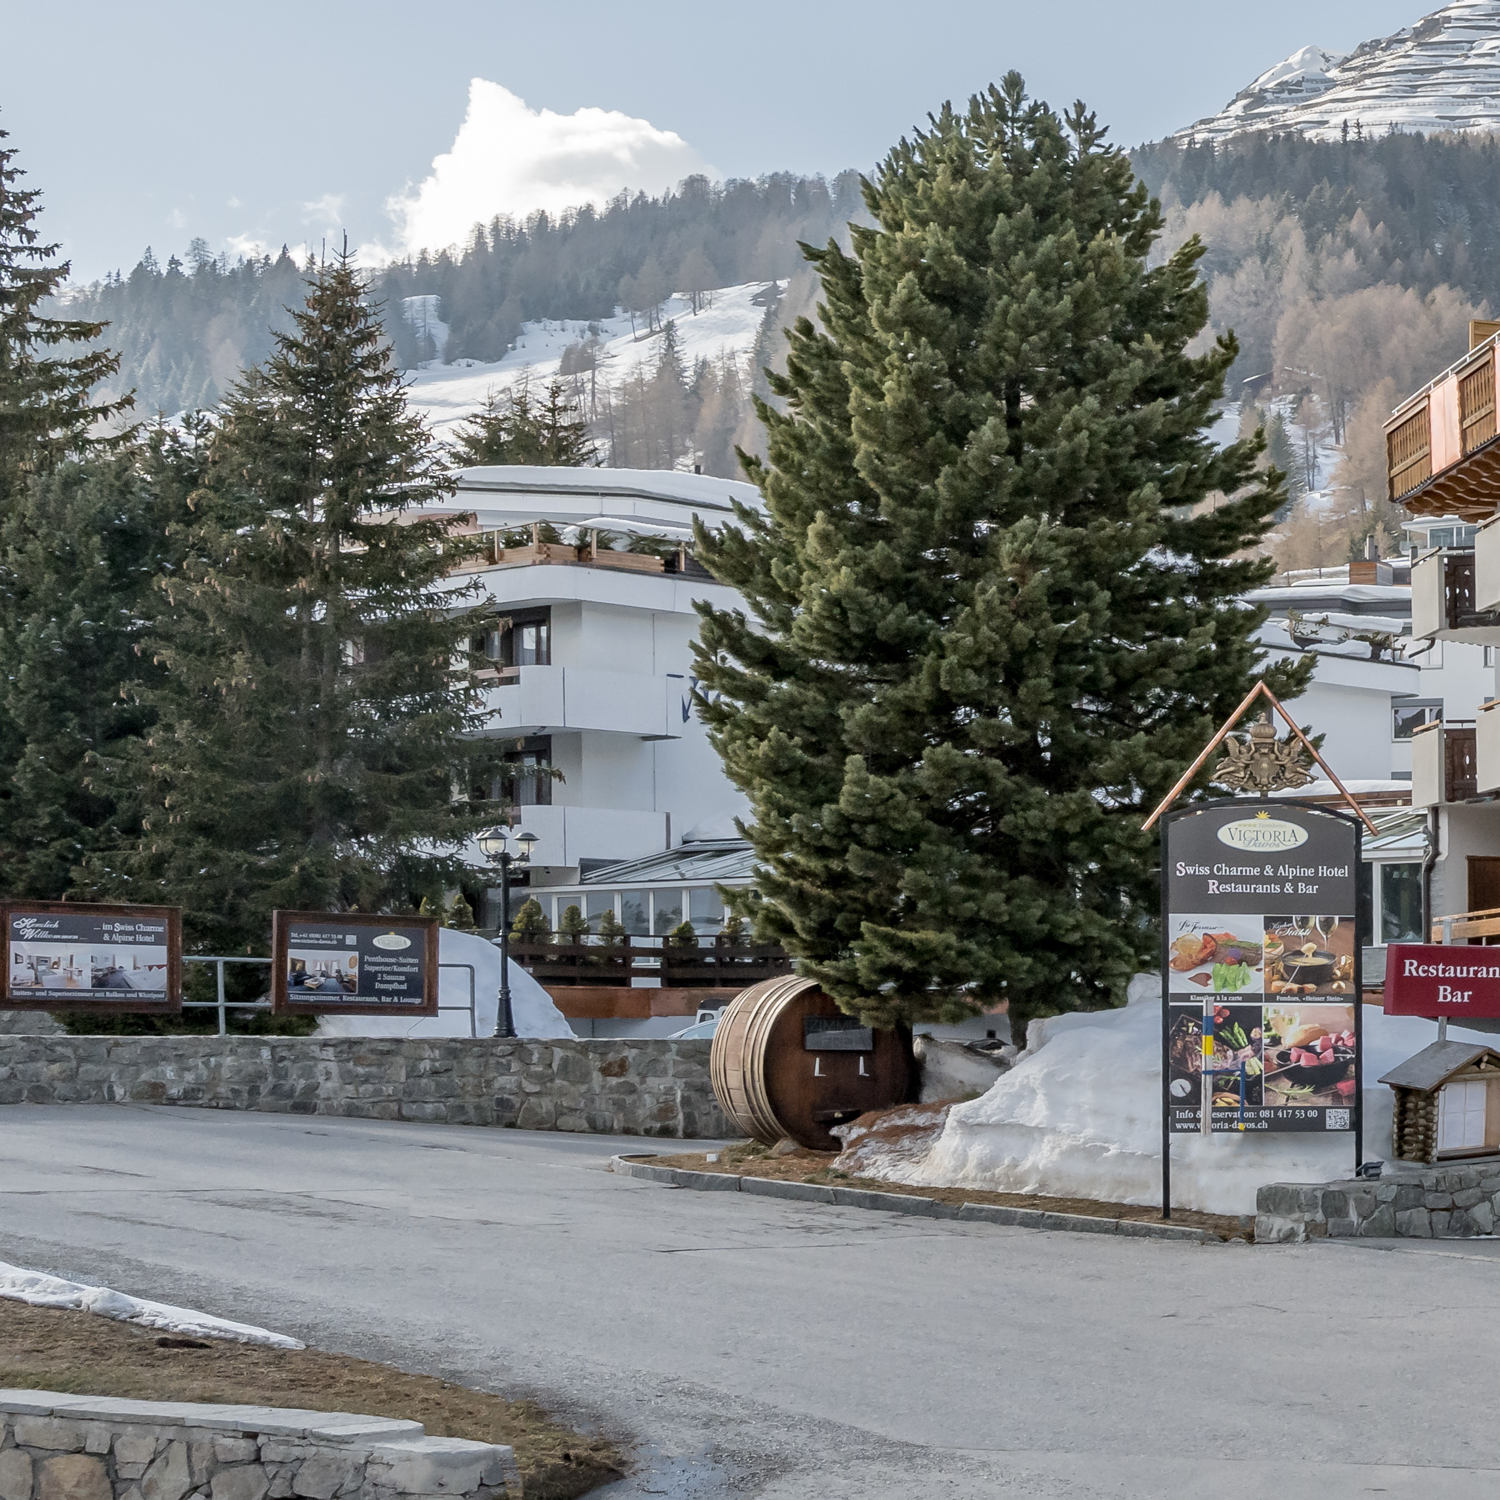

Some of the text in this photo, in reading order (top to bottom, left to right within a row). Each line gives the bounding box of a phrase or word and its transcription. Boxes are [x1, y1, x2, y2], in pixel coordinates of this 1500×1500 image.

[1227, 827, 1300, 847] VICTORIA
[1243, 837, 1281, 848] Davos
[1176, 861, 1348, 879] Swiss Charme & Alpine Hotel
[1207, 879, 1319, 894] Restaurants & Bar
[102, 923, 113, 931] im
[113, 922, 135, 932] Swiss
[135, 924, 165, 933] Charme
[111, 934, 135, 943] Alpine
[1437, 985, 1473, 1003] Bar
[1176, 1110, 1194, 1119] Info
[1207, 1110, 1258, 1119] eservaton:
[1259, 1110, 1275, 1118] 081
[1277, 1109, 1294, 1118] 417
[1294, 1110, 1306, 1119] 53
[1307, 1110, 1318, 1118] 00
